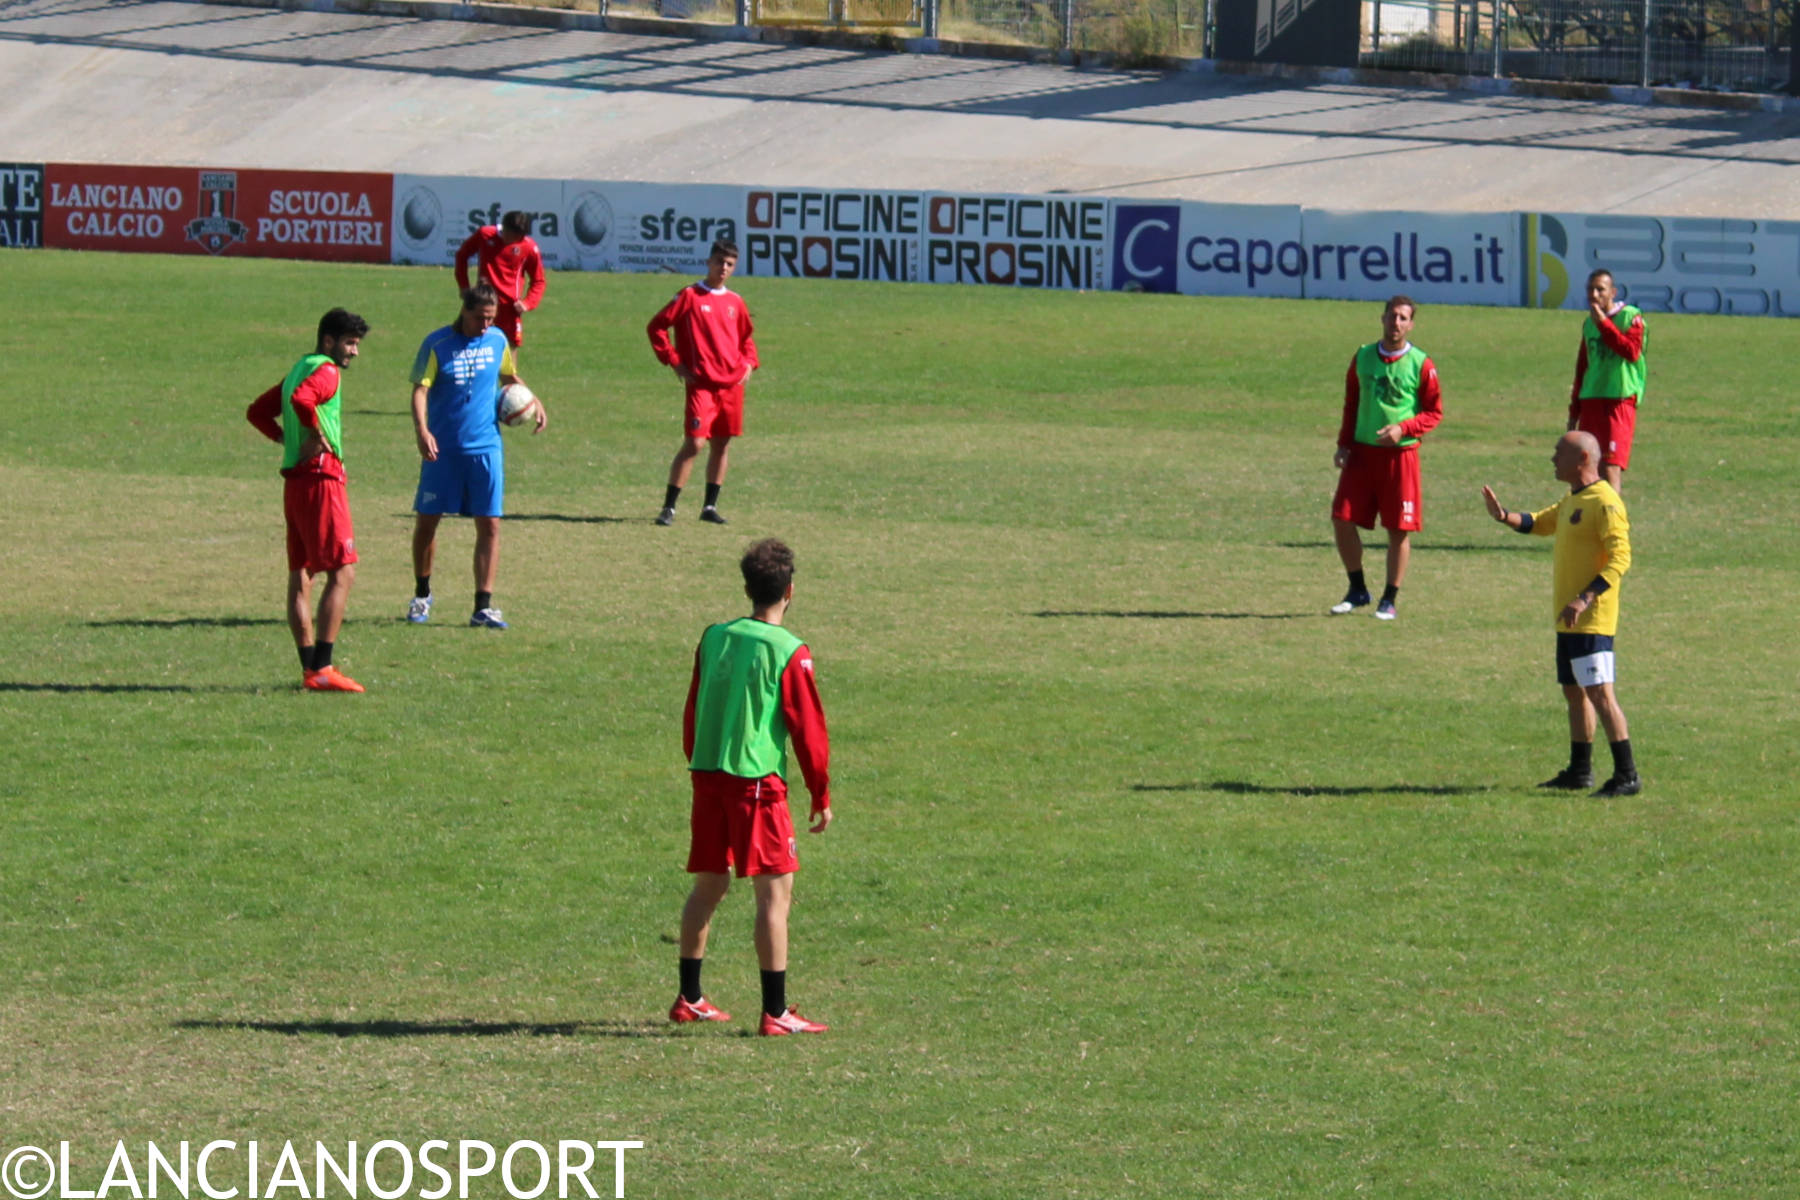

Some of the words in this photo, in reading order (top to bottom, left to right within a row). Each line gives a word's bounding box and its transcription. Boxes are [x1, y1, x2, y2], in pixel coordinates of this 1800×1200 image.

[51, 183, 182, 211] LANCIANO
[269, 190, 373, 216] SCUOLA
[746, 191, 918, 234] OFFICINE
[67, 211, 164, 238] CALCIO
[257, 218, 384, 246] PORTIERI
[468, 202, 559, 237] sfra
[640, 207, 737, 243] sfera
[929, 196, 1104, 241] OFFICINE
[746, 234, 908, 283] PROSINI
[928, 239, 1092, 290] PROSINI
[1186, 231, 1504, 289] caporrella.it
